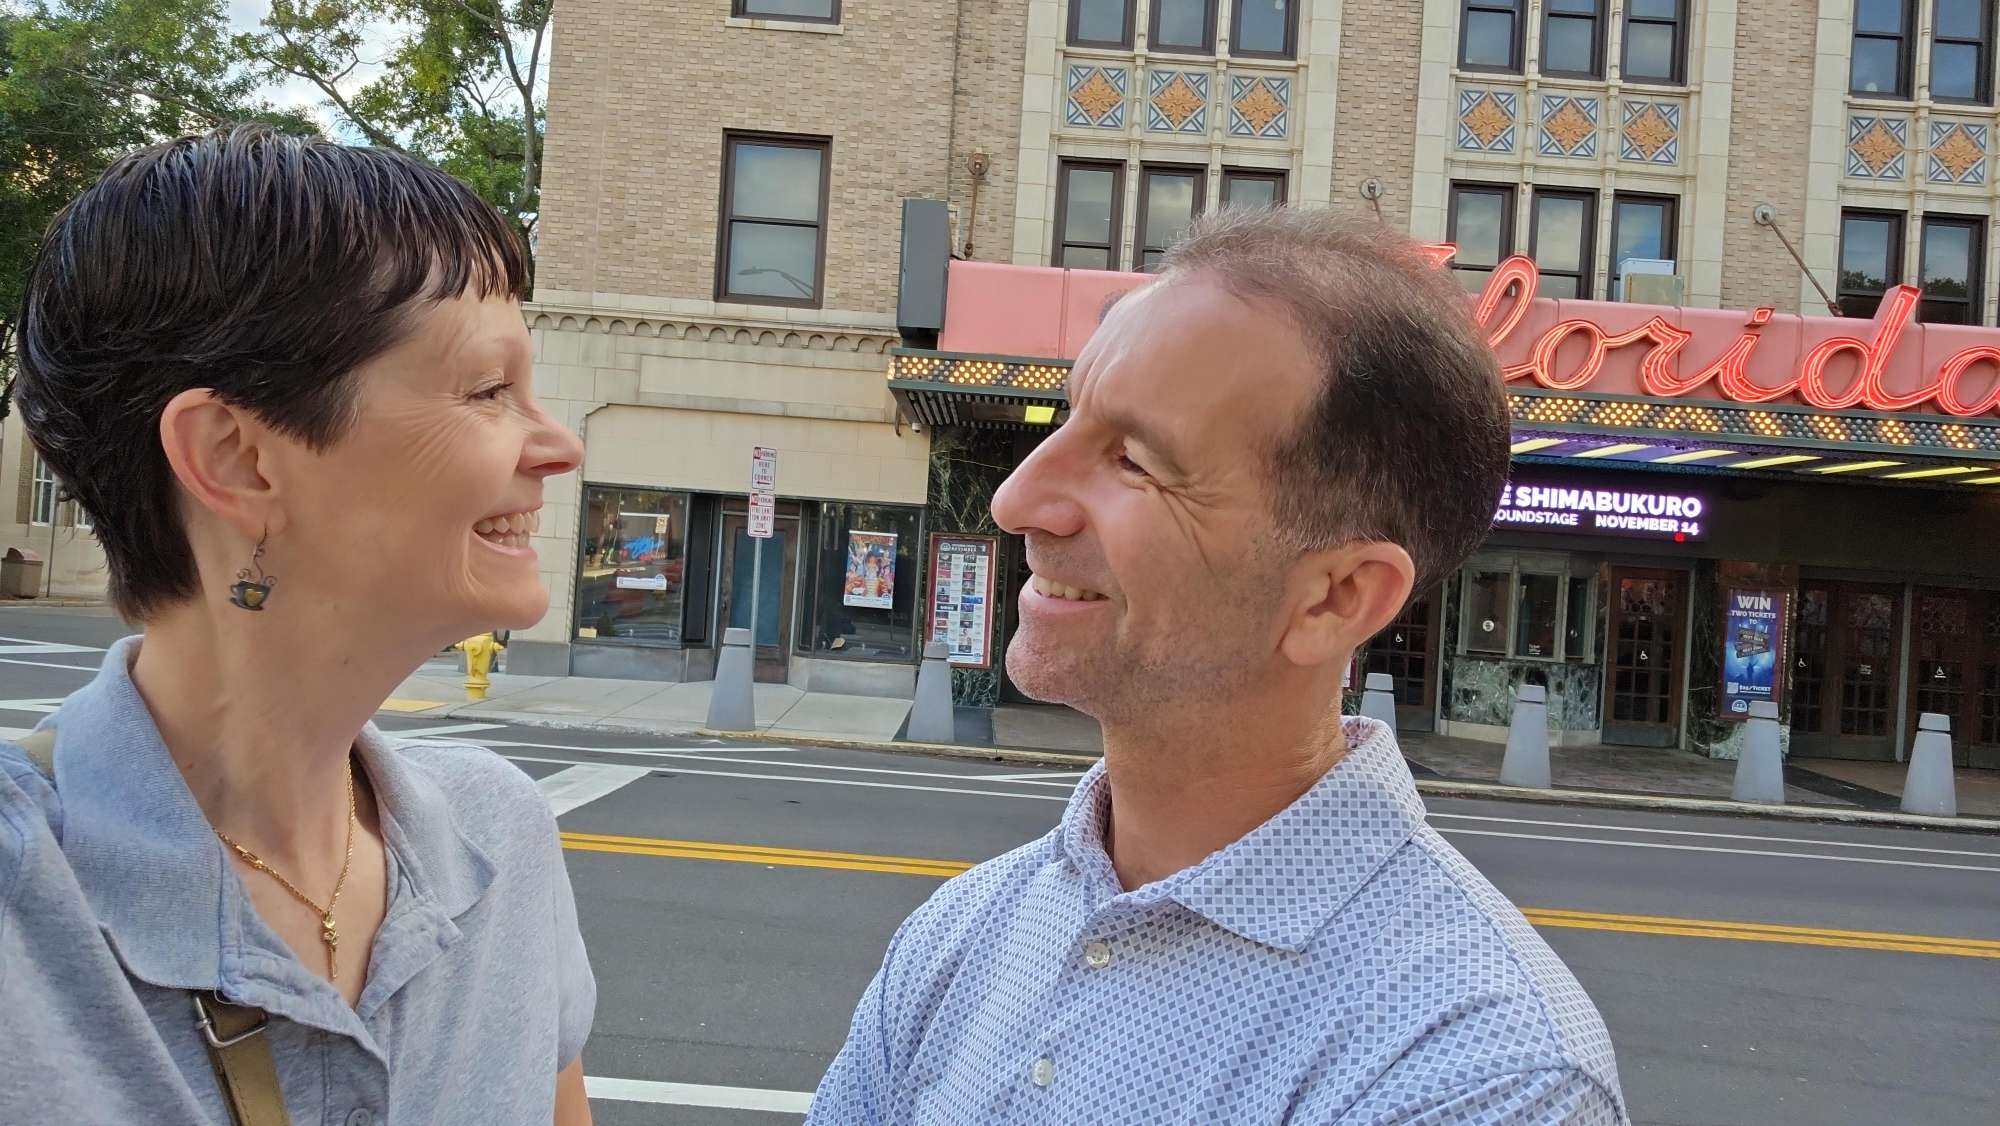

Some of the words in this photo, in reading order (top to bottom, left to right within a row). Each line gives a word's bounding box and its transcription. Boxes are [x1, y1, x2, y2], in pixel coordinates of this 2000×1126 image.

[1422, 242, 2000, 416] lorida
[1515, 486, 1702, 518] SHIMABUKURO
[1494, 509, 1579, 526] OUNDSTAGE
[1595, 514, 1679, 533] NOVEMBER
[1680, 522, 1700, 536] 14
[1737, 595, 1771, 610] WIN
[1748, 611, 1776, 619] TICKETS
